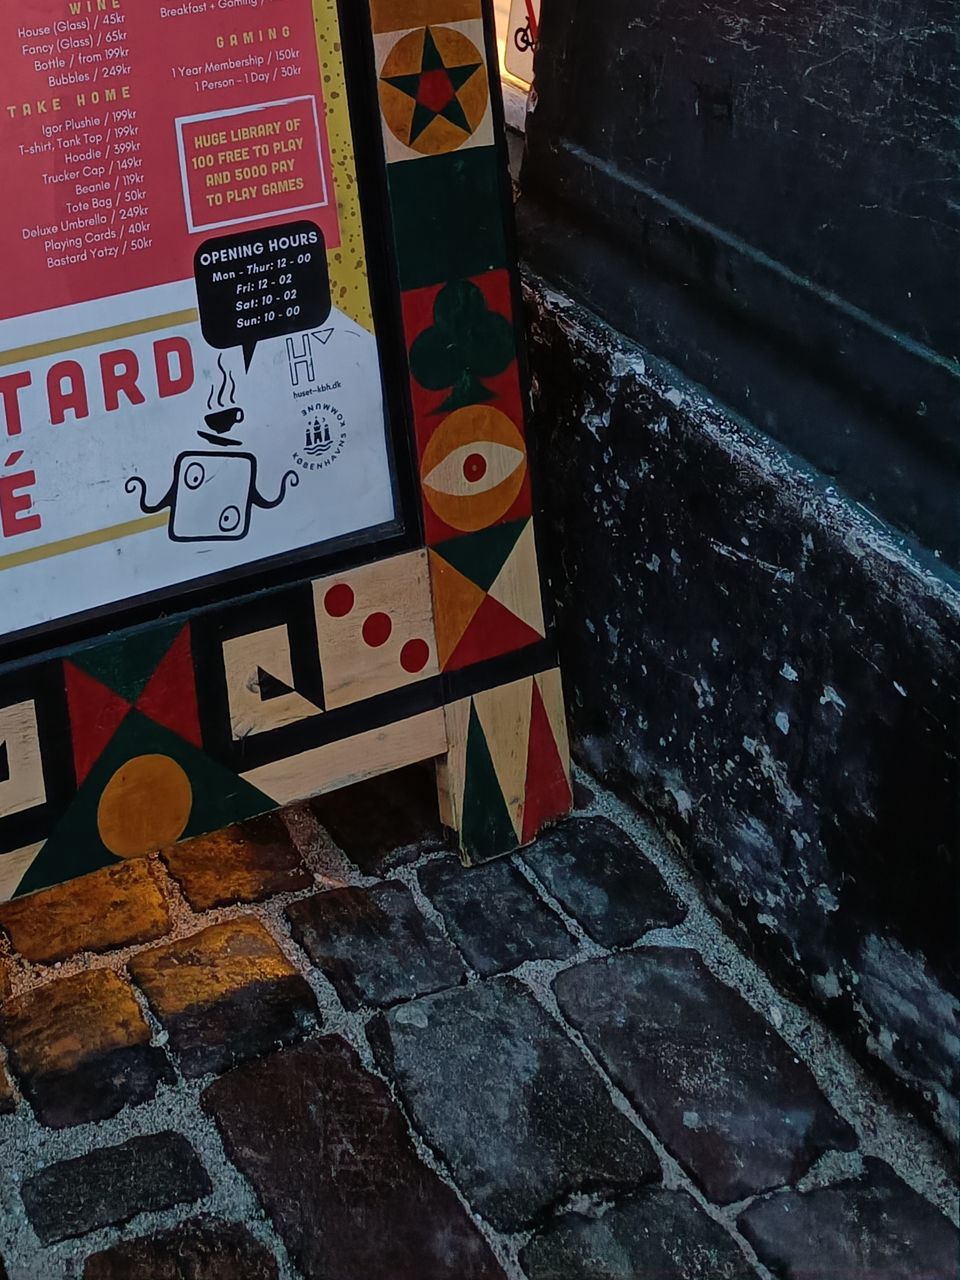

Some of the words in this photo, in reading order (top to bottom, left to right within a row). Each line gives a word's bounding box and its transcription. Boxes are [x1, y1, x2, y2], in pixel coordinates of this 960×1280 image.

[17, 26, 50, 38] House
[53, 16, 90, 36] (Glass)
[102, 11, 125, 24] 45kr
[216, 25, 290, 48] GAMING
[34, 56, 66, 71] Bottle
[78, 52, 102, 64] from
[104, 45, 129, 60] 199kr
[48, 71, 90, 87] Bubbles
[101, 63, 131, 78] 249kr
[6, 98, 61, 118] TAKE
[76, 86, 130, 107] HOME
[41, 124, 62, 138] Igor
[64, 116, 101, 131] Plushie
[112, 108, 136, 122] 199kr
[194, 131, 227, 149] HUGE
[230, 121, 281, 142] LIBRARY
[285, 118, 301, 132] OF
[64, 147, 102, 164] Hoodie
[113, 140, 140, 155] 399kr
[191, 154, 214, 169] 100
[217, 147, 250, 165] FREE
[252, 143, 269, 157] TO
[272, 137, 303, 154] PLAY
[42, 169, 80, 184] Trucker
[82, 165, 105, 178] Cap
[116, 156, 142, 170] 149kr
[205, 170, 231, 187] AND
[234, 163, 267, 181] 5000
[271, 158, 295, 174] PAY
[205, 192, 223, 207] TO
[226, 185, 257, 203] PLAY
[261, 177, 304, 196] GAMES
[200, 242, 264, 266] OPENING
[268, 231, 317, 252] HOURS
[212, 271, 235, 282] Mon
[246, 262, 274, 274] Thur:
[277, 257, 286, 268] 12
[297, 252, 311, 264] 00
[236, 282, 254, 294] Fri:
[258, 278, 268, 290] 12
[278, 273, 292, 285] 02
[235, 298, 258, 311] Sat:
[262, 294, 273, 305] 10
[283, 288, 297, 300] 02
[236, 316, 261, 328] Sun:
[264, 310, 275, 322] 10
[285, 305, 300, 317] 00
[292, 380, 342, 399] huset-kbh.dk
[301, 402, 347, 427] KOMMUNE
[291, 432, 347, 471] KØBENHAVNS
